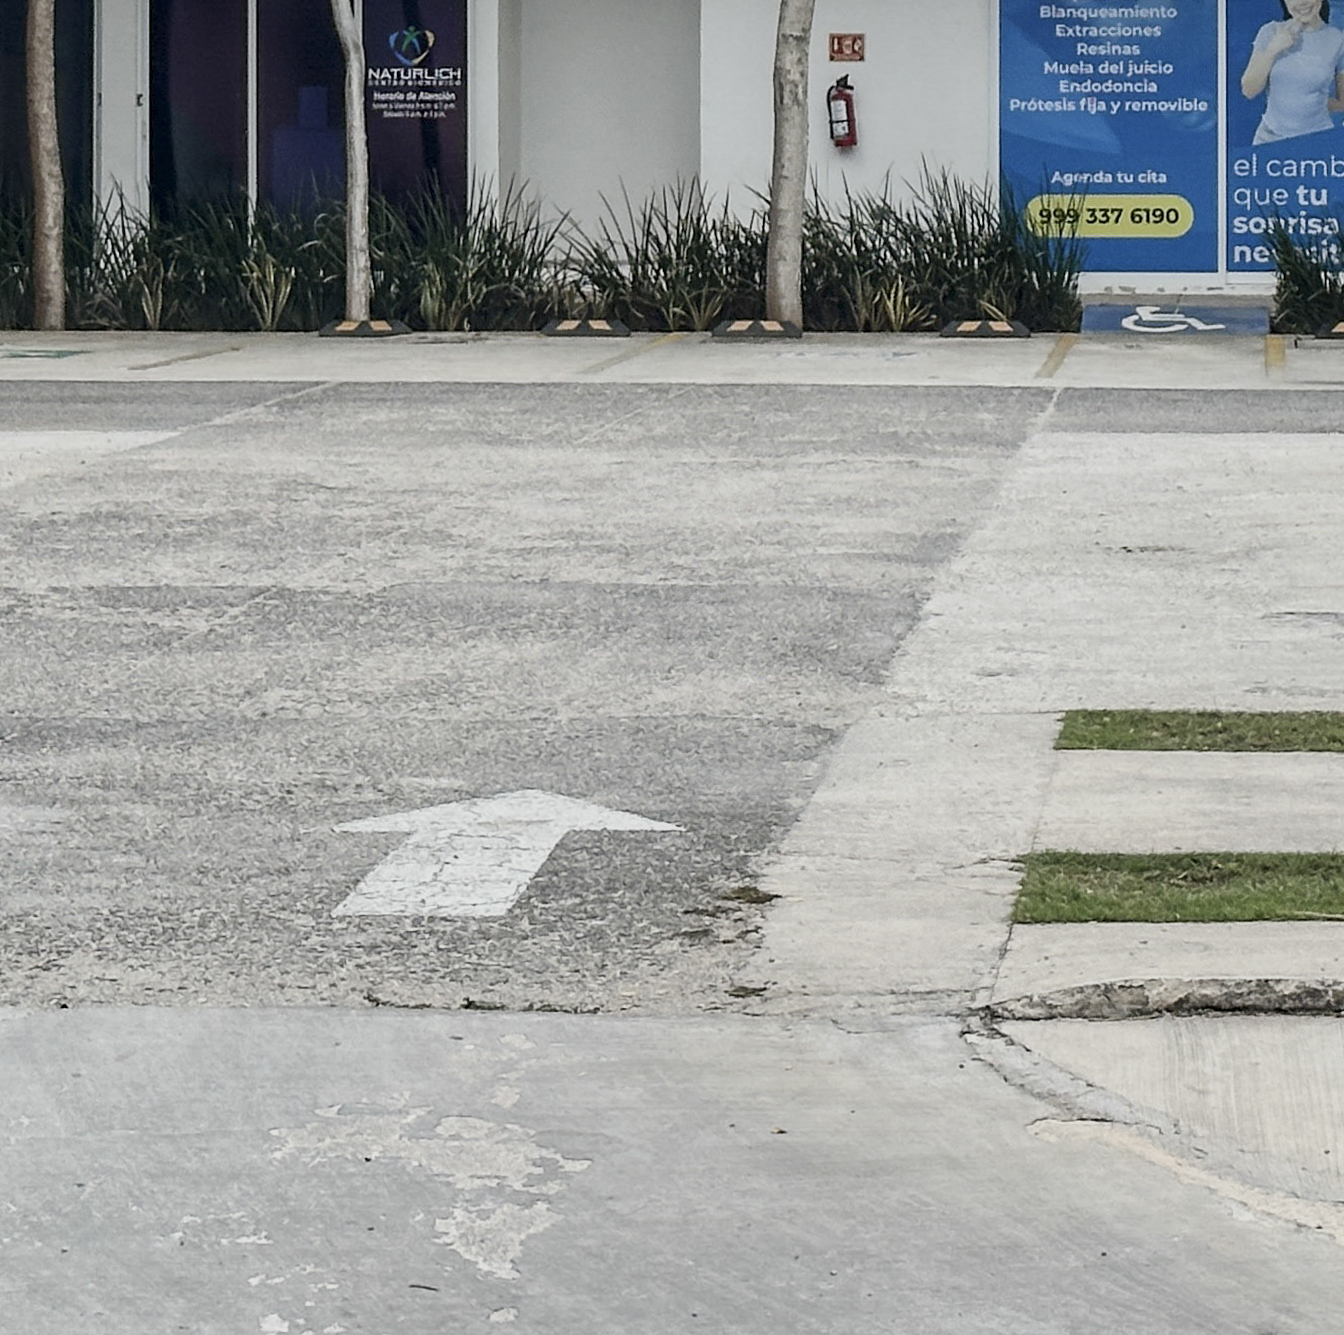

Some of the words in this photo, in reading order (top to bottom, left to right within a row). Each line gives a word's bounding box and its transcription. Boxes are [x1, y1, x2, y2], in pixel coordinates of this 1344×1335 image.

[1039, 5, 1178, 21] Blanqueamiento
[1055, 24, 1162, 37] Extracciones
[1077, 42, 1141, 56] Resinas
[368, 68, 462, 80] NATURLICH
[1043, 61, 1094, 74] Muela
[1098, 61, 1124, 74] del
[1126, 60, 1174, 77] juicio
[1059, 79, 1158, 93] Endodoncia
[1010, 96, 1076, 111] Prótesis
[1079, 96, 1106, 115] fija
[1110, 101, 1121, 115] y
[1125, 97, 1209, 111] removible
[1233, 153, 1258, 177] el
[1051, 170, 1113, 187] Agenda
[1116, 171, 1134, 183] tu
[1137, 169, 1168, 184] cita
[1233, 187, 1289, 211] que
[1295, 184, 1328, 206] tu
[1039, 207, 1081, 225] 999
[1085, 207, 1124, 225] 337
[1130, 207, 1180, 225] 6190
